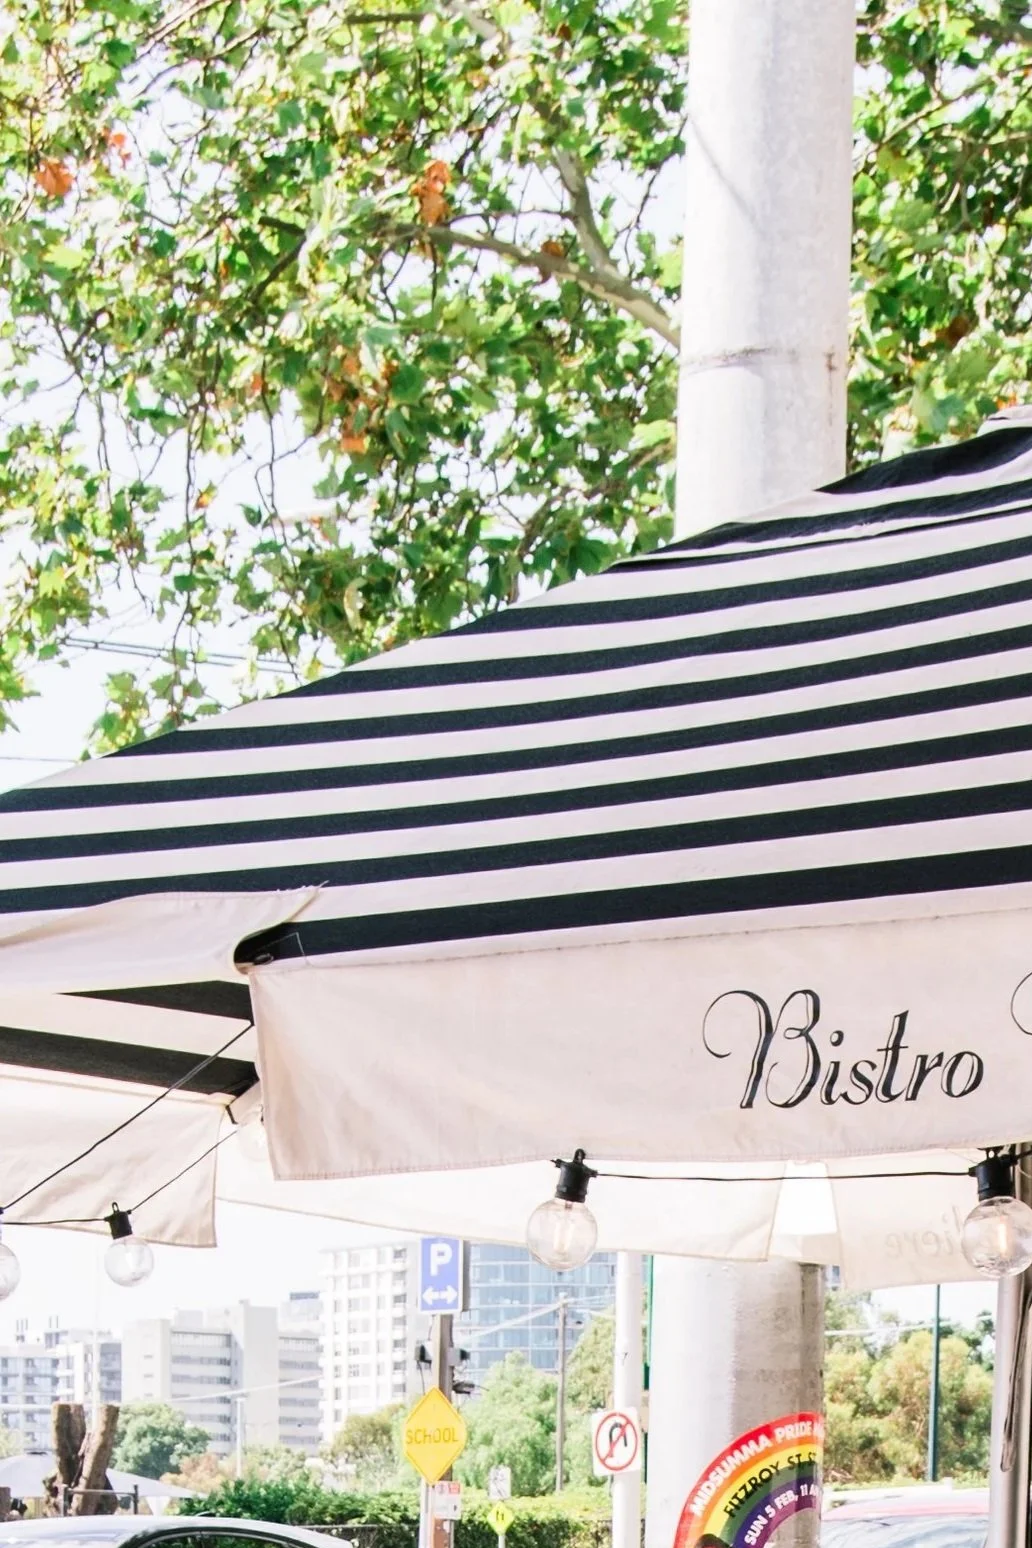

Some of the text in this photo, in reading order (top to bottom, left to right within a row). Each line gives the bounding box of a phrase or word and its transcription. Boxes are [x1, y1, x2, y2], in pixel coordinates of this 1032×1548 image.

[702, 989, 984, 1109] Bistro
[430, 1243, 452, 1277] P
[405, 1426, 459, 1446] SCHOOL
[691, 1421, 813, 1517] MIDSUMMA PRIDE
[723, 1461, 780, 1518] FITZROY
[744, 1514, 768, 1546] SUN
[764, 1505, 776, 1518] 5
